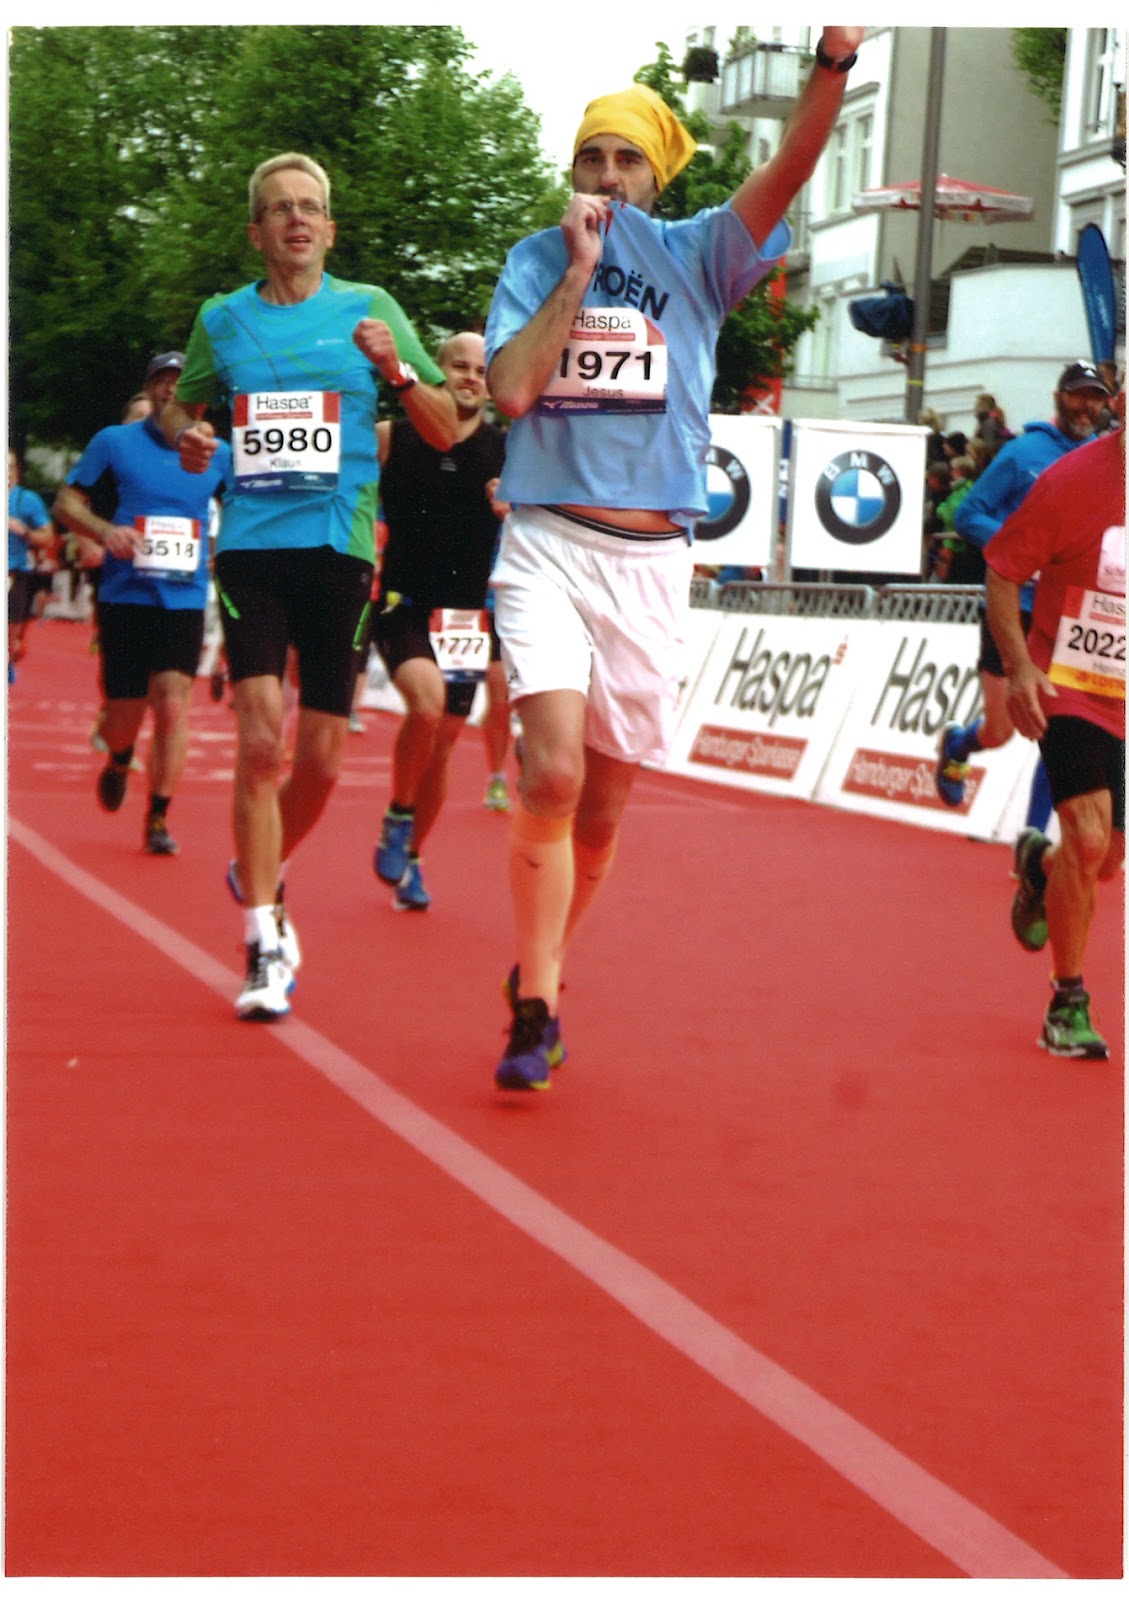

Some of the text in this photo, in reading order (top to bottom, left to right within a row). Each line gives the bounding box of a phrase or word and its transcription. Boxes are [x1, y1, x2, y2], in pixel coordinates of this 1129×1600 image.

[592, 262, 670, 321] ROËN
[560, 347, 651, 381] 1971
[256, 395, 309, 411] Haspa
[583, 386, 625, 397] Jesus
[243, 427, 332, 455] 5980
[823, 451, 896, 486] BMW
[437, 637, 484, 655] 1777
[714, 627, 832, 728] Haspa
[871, 636, 985, 736] Hasp
